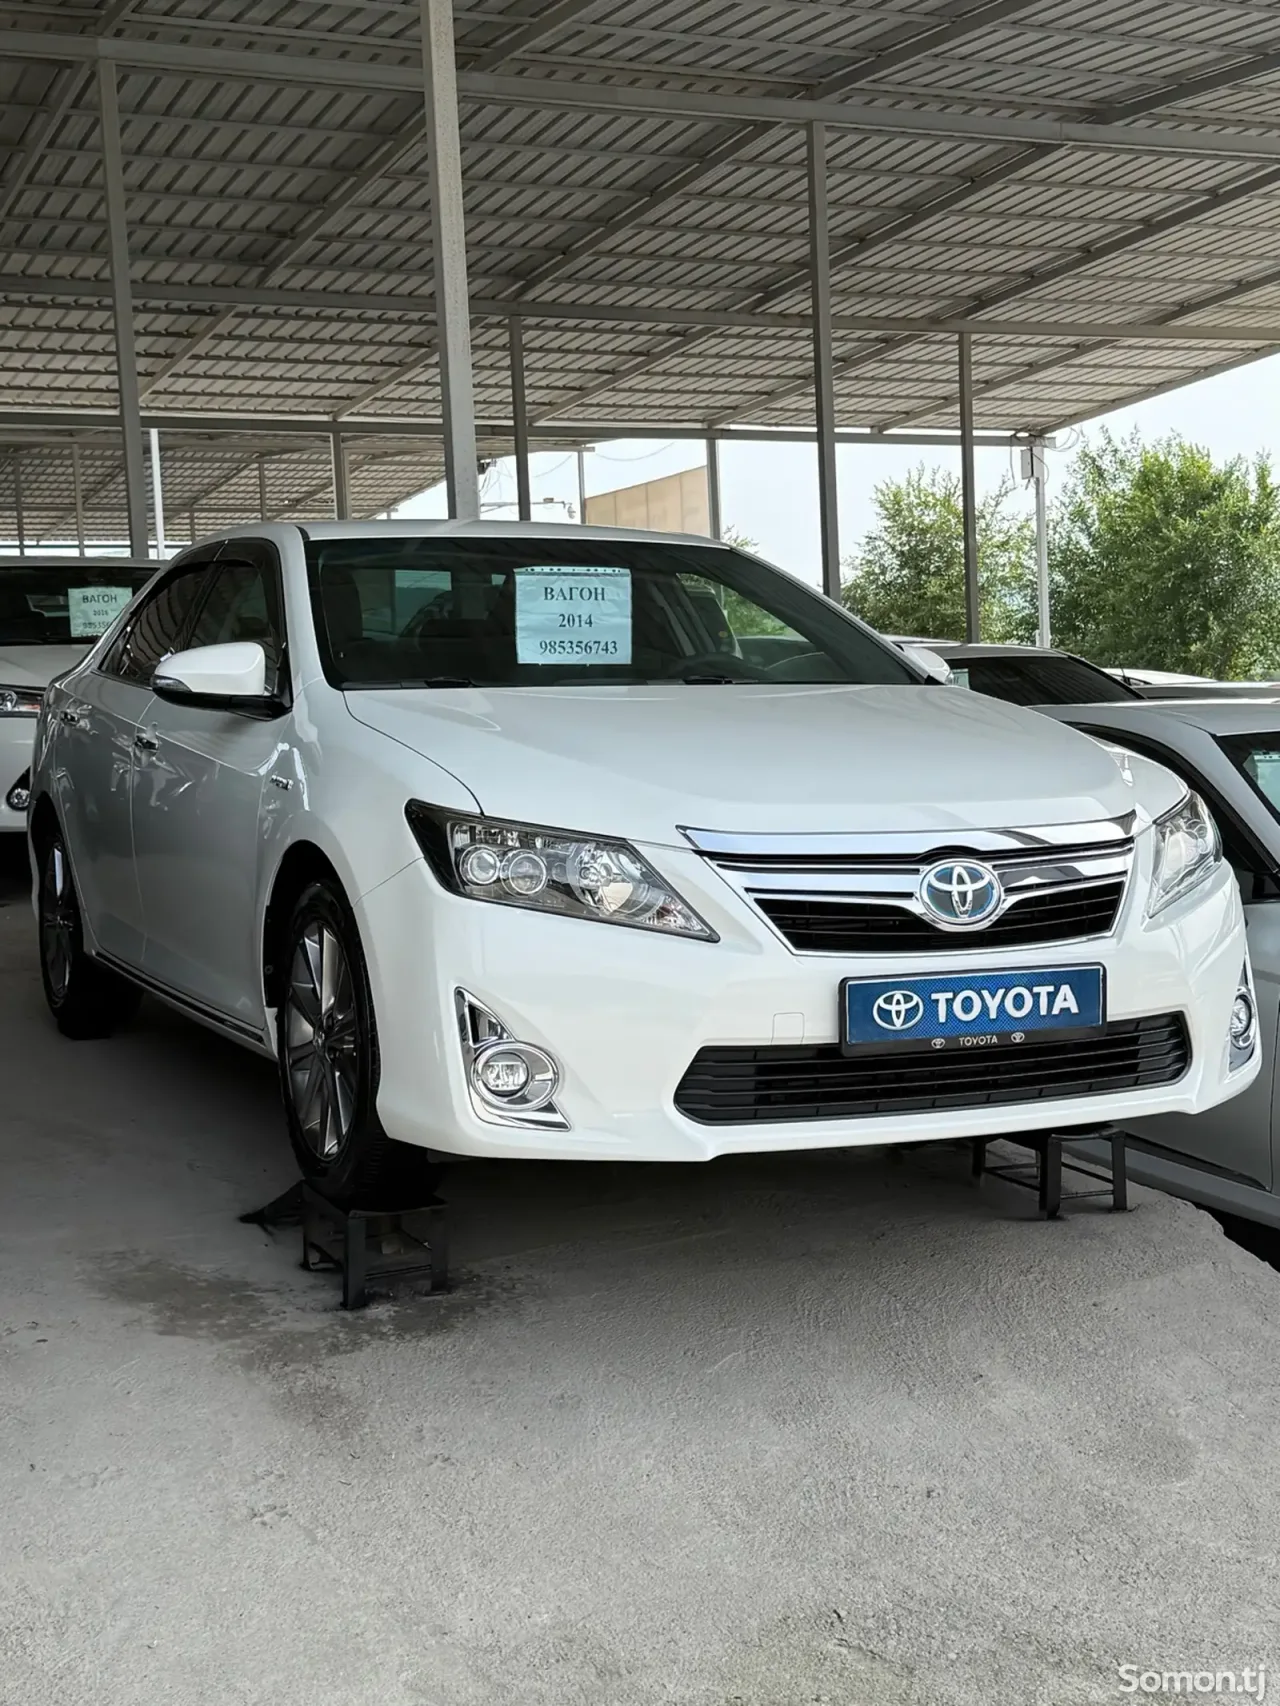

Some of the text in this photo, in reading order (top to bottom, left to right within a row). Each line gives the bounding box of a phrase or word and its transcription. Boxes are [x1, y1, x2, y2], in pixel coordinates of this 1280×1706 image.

[82, 594, 117, 604] ВАГОН
[544, 586, 605, 601] ВАГОН
[558, 613, 593, 628] 2014
[539, 640, 618, 655] 985356743
[931, 984, 1079, 1023] TOYOTA
[958, 1034, 998, 1047] TOYOTA
